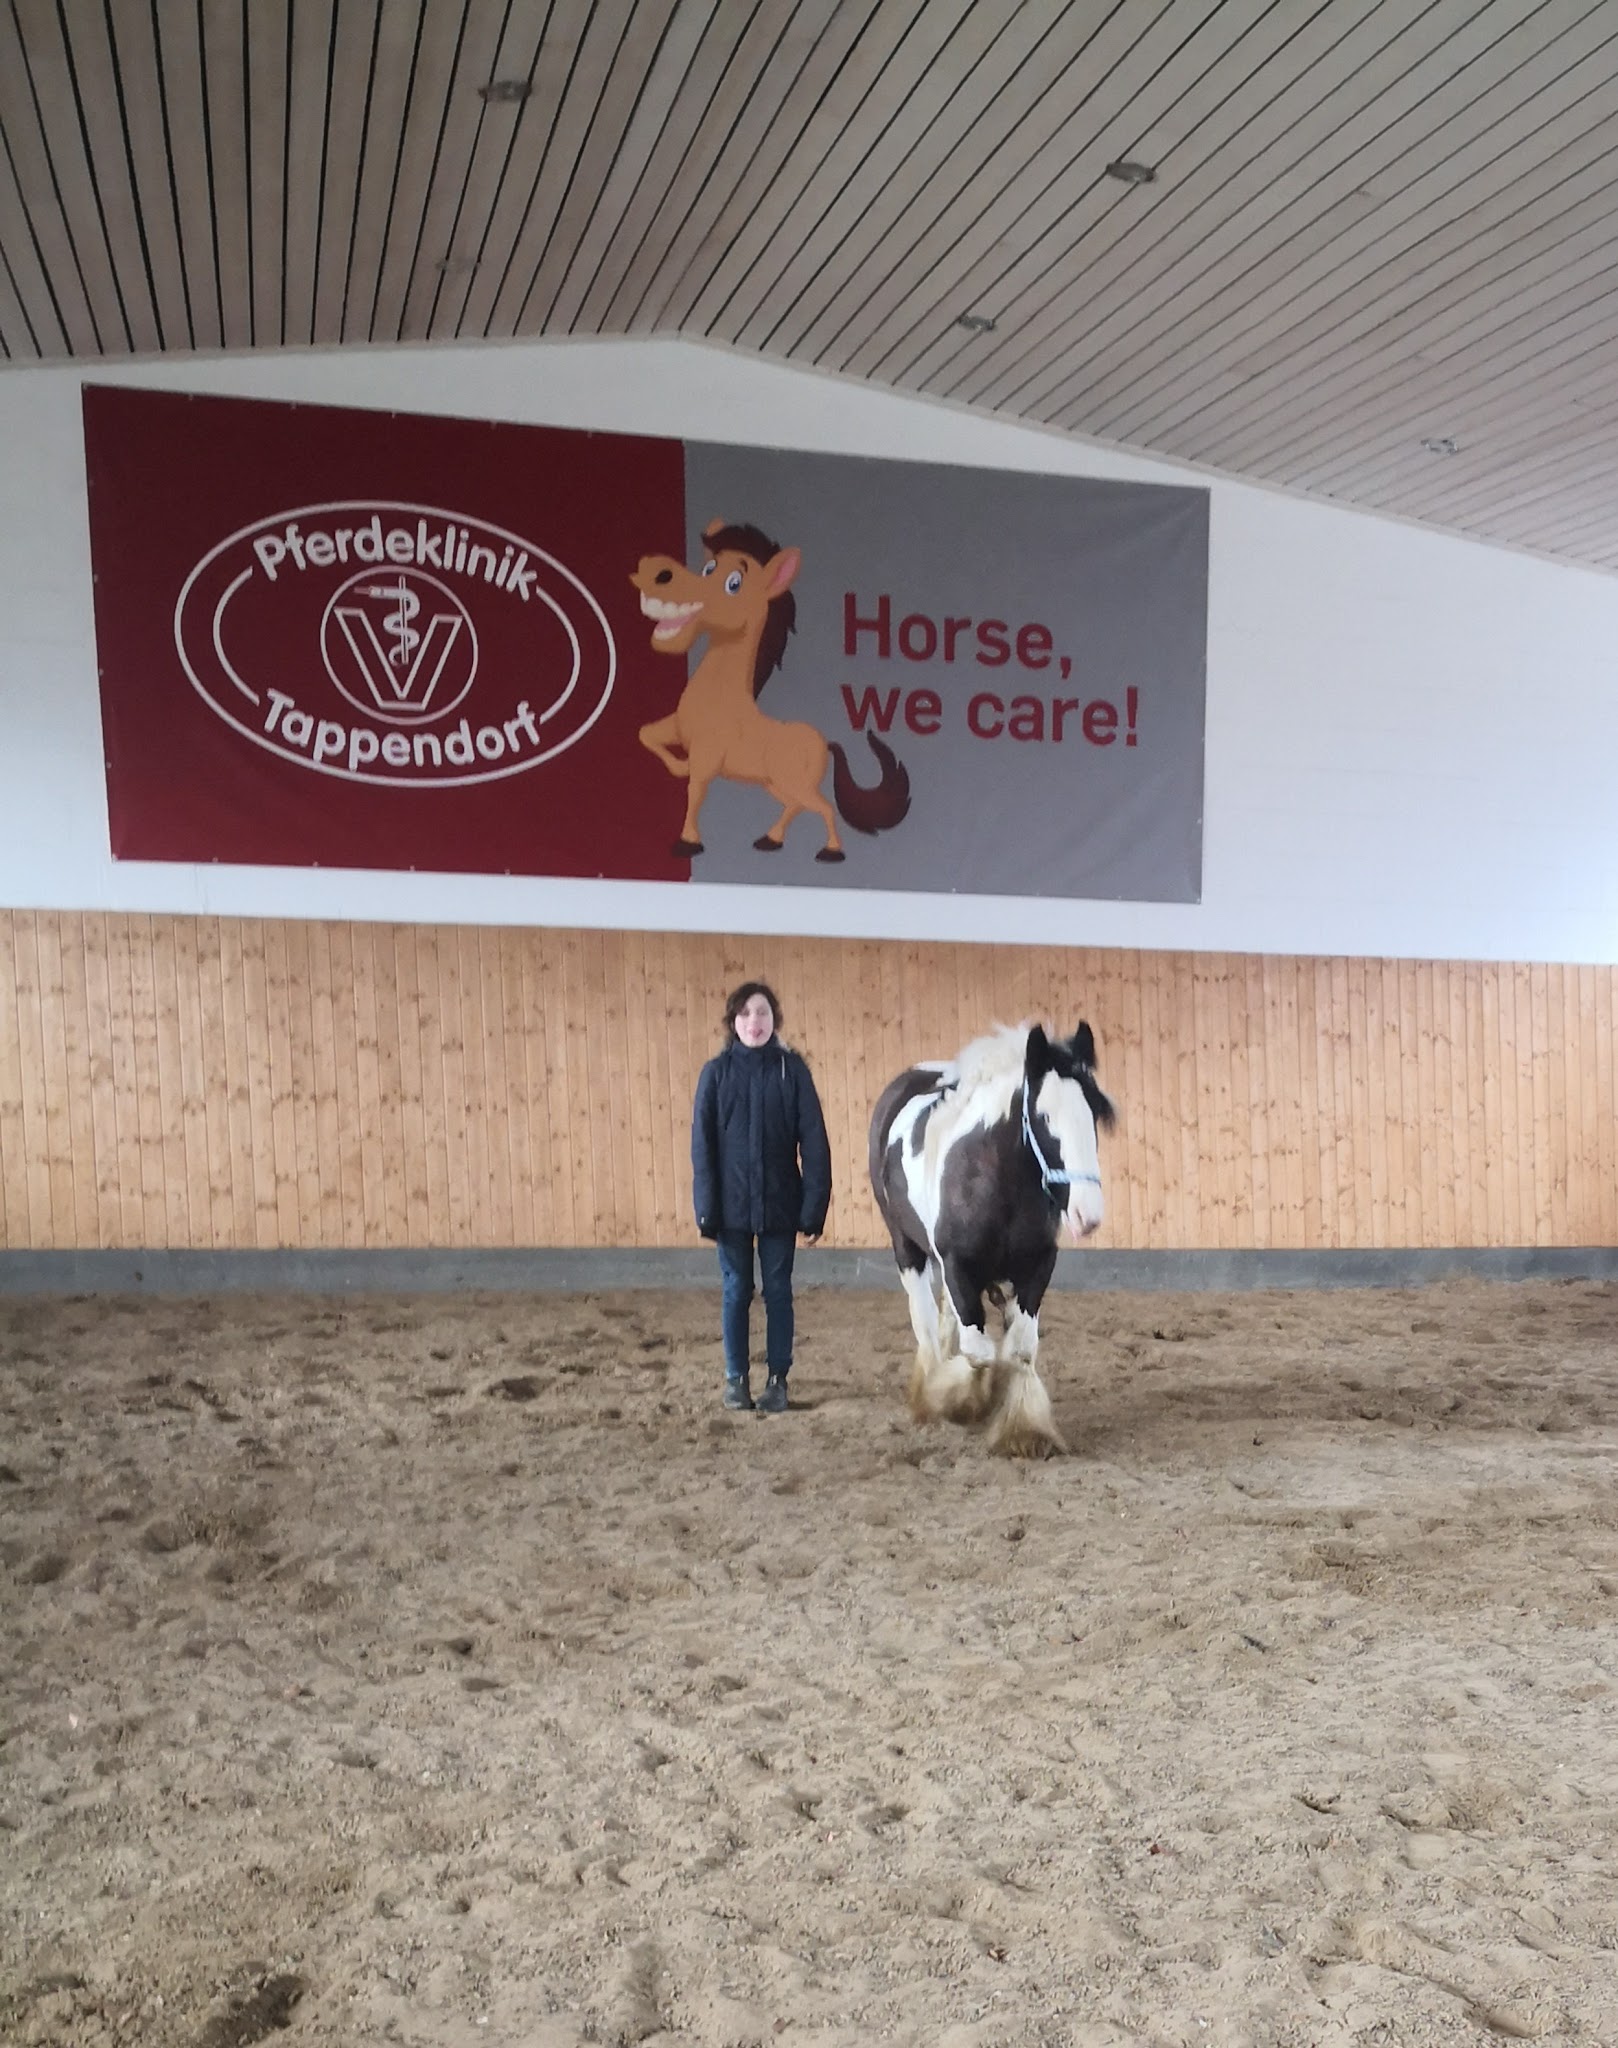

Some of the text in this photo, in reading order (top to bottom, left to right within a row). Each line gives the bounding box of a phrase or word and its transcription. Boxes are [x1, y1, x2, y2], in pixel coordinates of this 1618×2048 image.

[253, 514, 538, 601] Pferdeklinik
[844, 591, 1072, 680] Horse,
[263, 688, 540, 773] Tappendorf
[840, 683, 1139, 747] we care!
